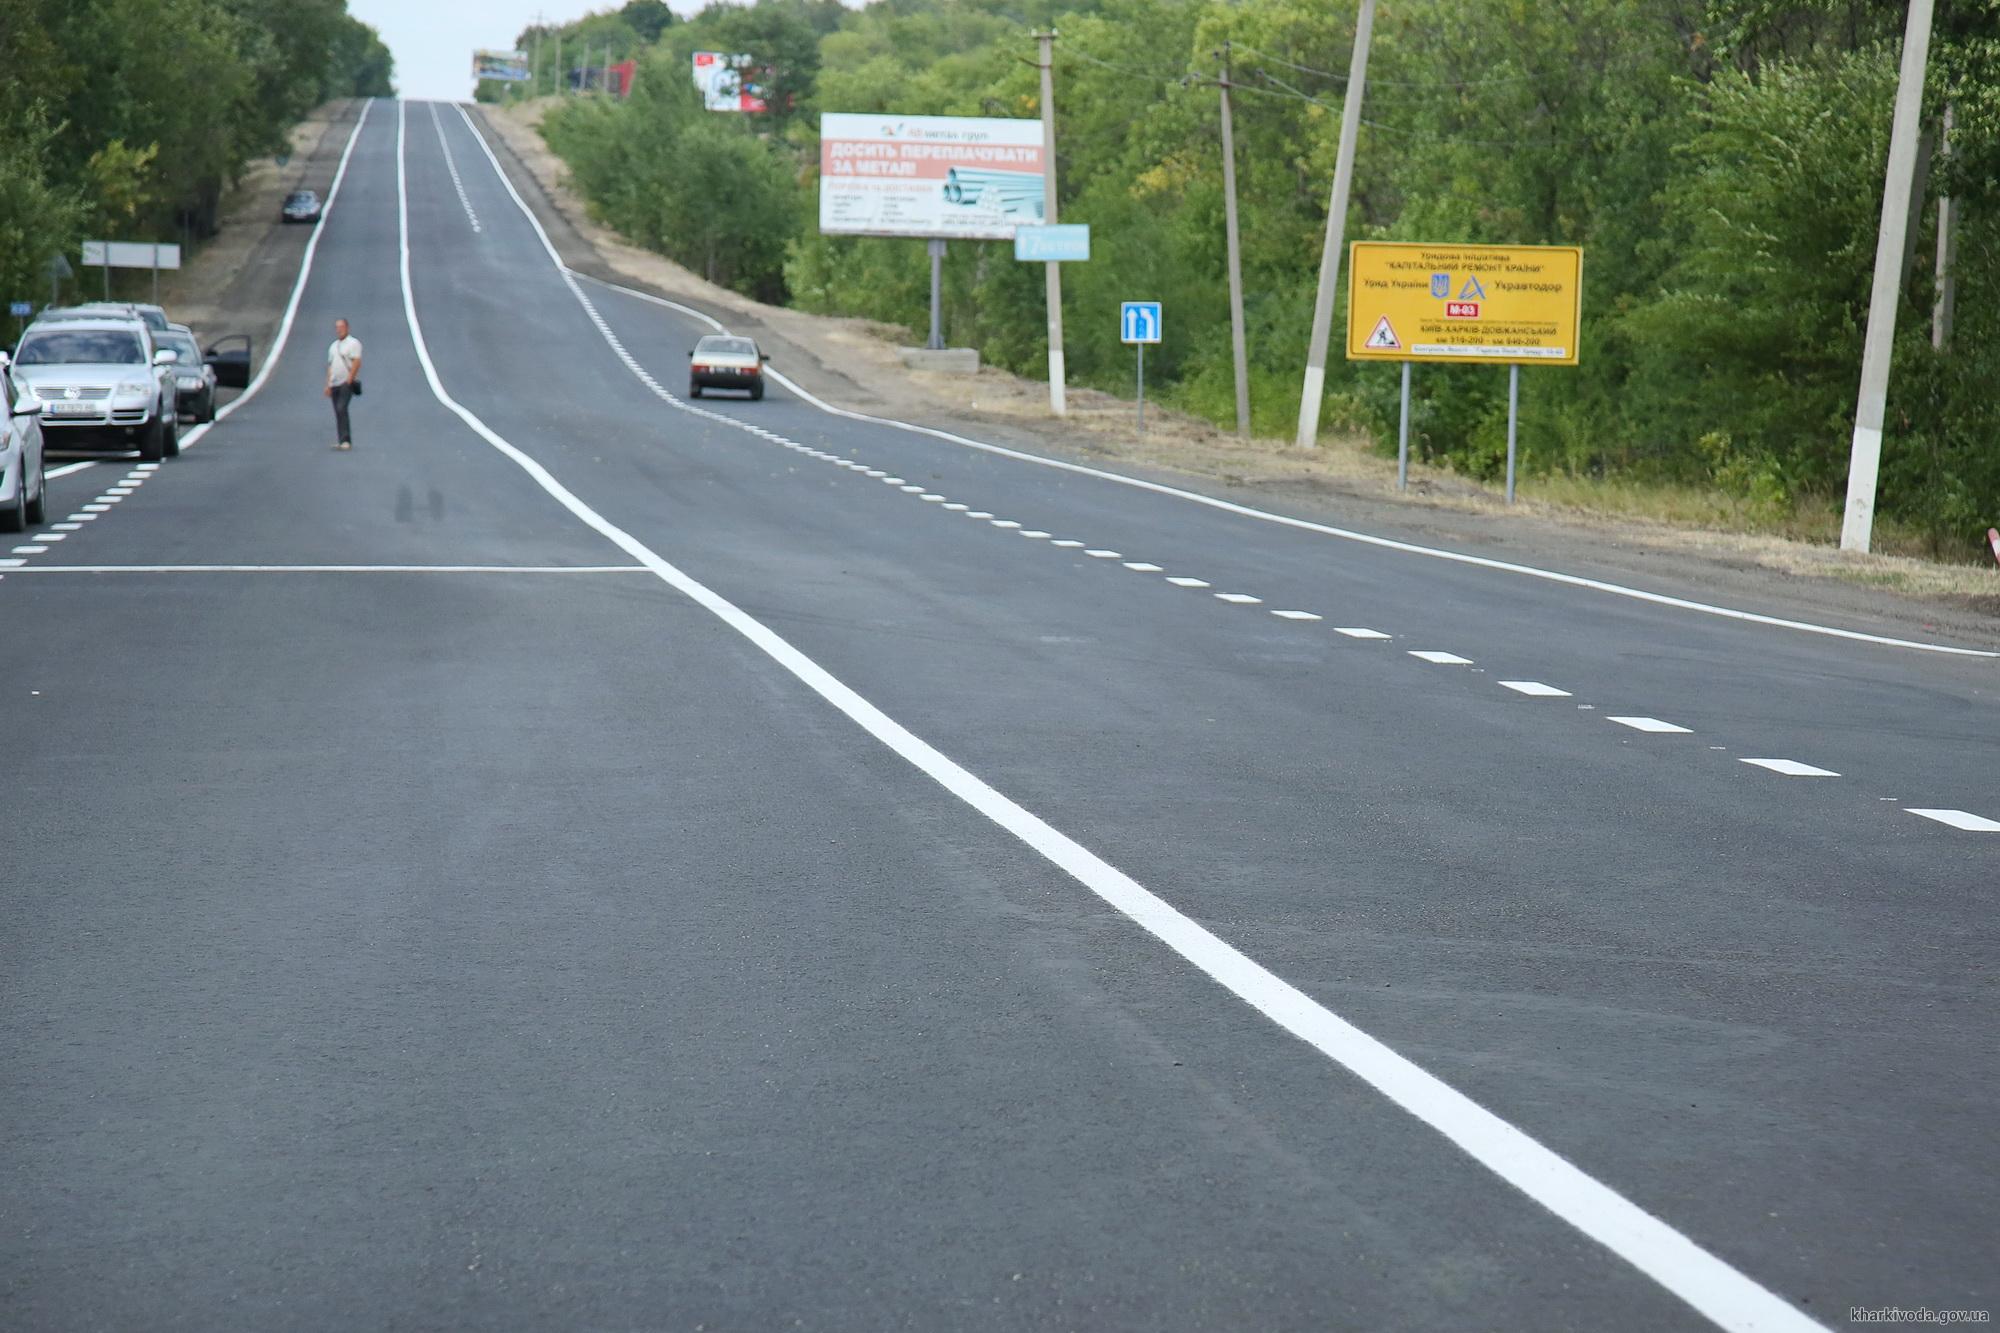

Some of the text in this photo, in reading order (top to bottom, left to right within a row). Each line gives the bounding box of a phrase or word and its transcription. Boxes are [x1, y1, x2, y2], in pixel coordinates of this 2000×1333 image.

[831, 143, 1038, 162] ДОСИТЬ ПЕРЕПЛАЧУВАТИ
[833, 160, 854, 175] ЗА
[1461, 263, 1502, 272] РЕМОНТ
[1391, 279, 1429, 290] України
[1495, 280, 1562, 293] Укравтодор
